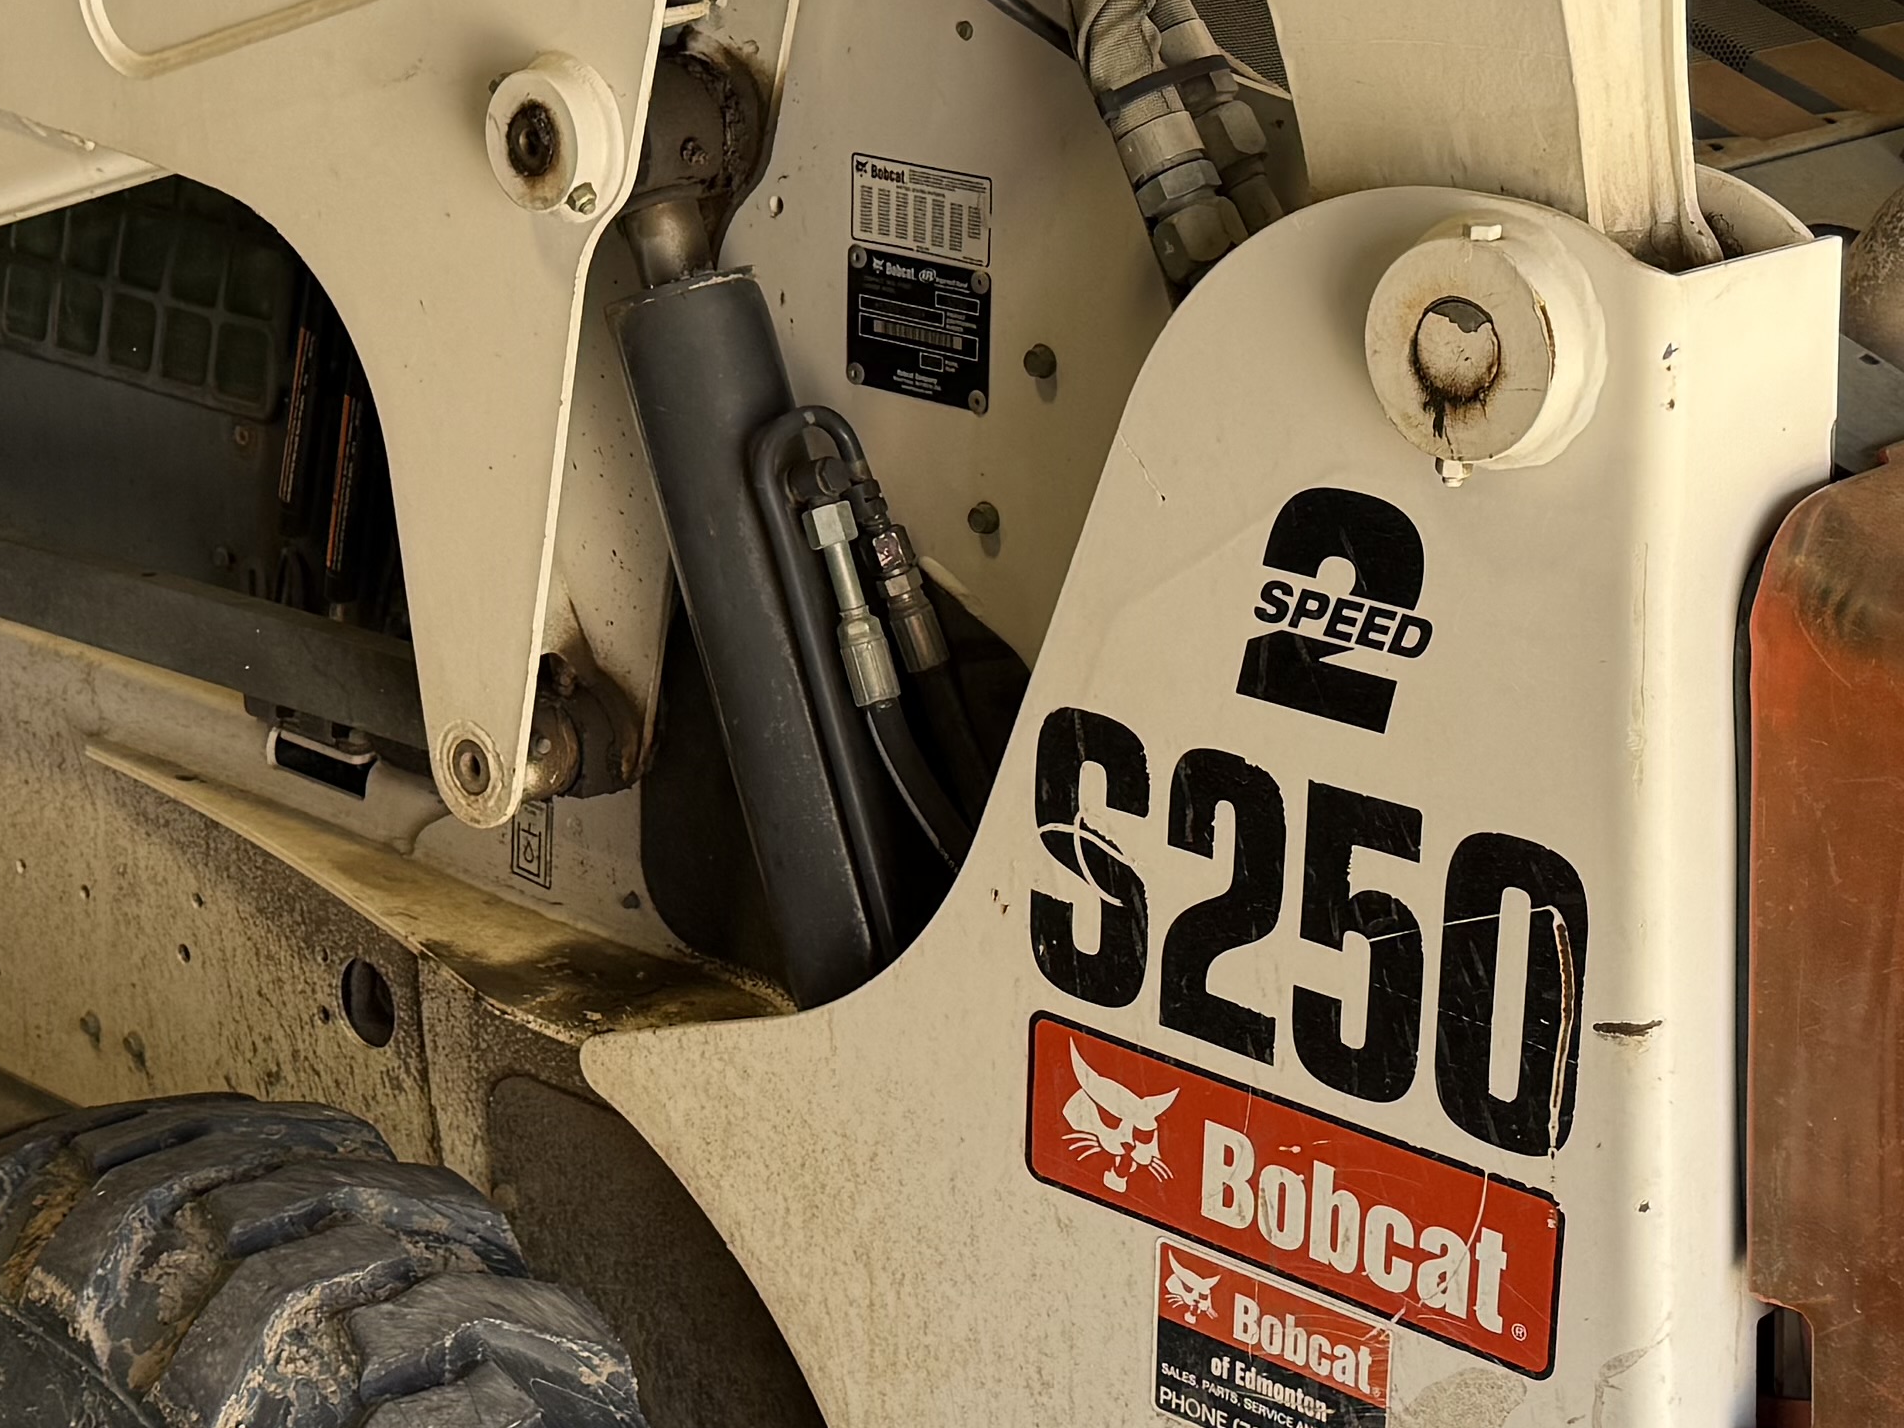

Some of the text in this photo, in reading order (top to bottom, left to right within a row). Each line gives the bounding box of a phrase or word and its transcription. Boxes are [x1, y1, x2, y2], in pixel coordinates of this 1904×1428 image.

[871, 164, 905, 184] Bobcat
[1236, 487, 1426, 734] 2
[1254, 580, 1433, 660] SPEED
[1029, 706, 1589, 1157] S250
[1200, 1119, 1509, 1334] Bobcat
[1233, 1292, 1373, 1394] Bobcat
[1211, 1356, 1328, 1423] of Edmonton
[1243, 1398, 1294, 1428] SERVICE
